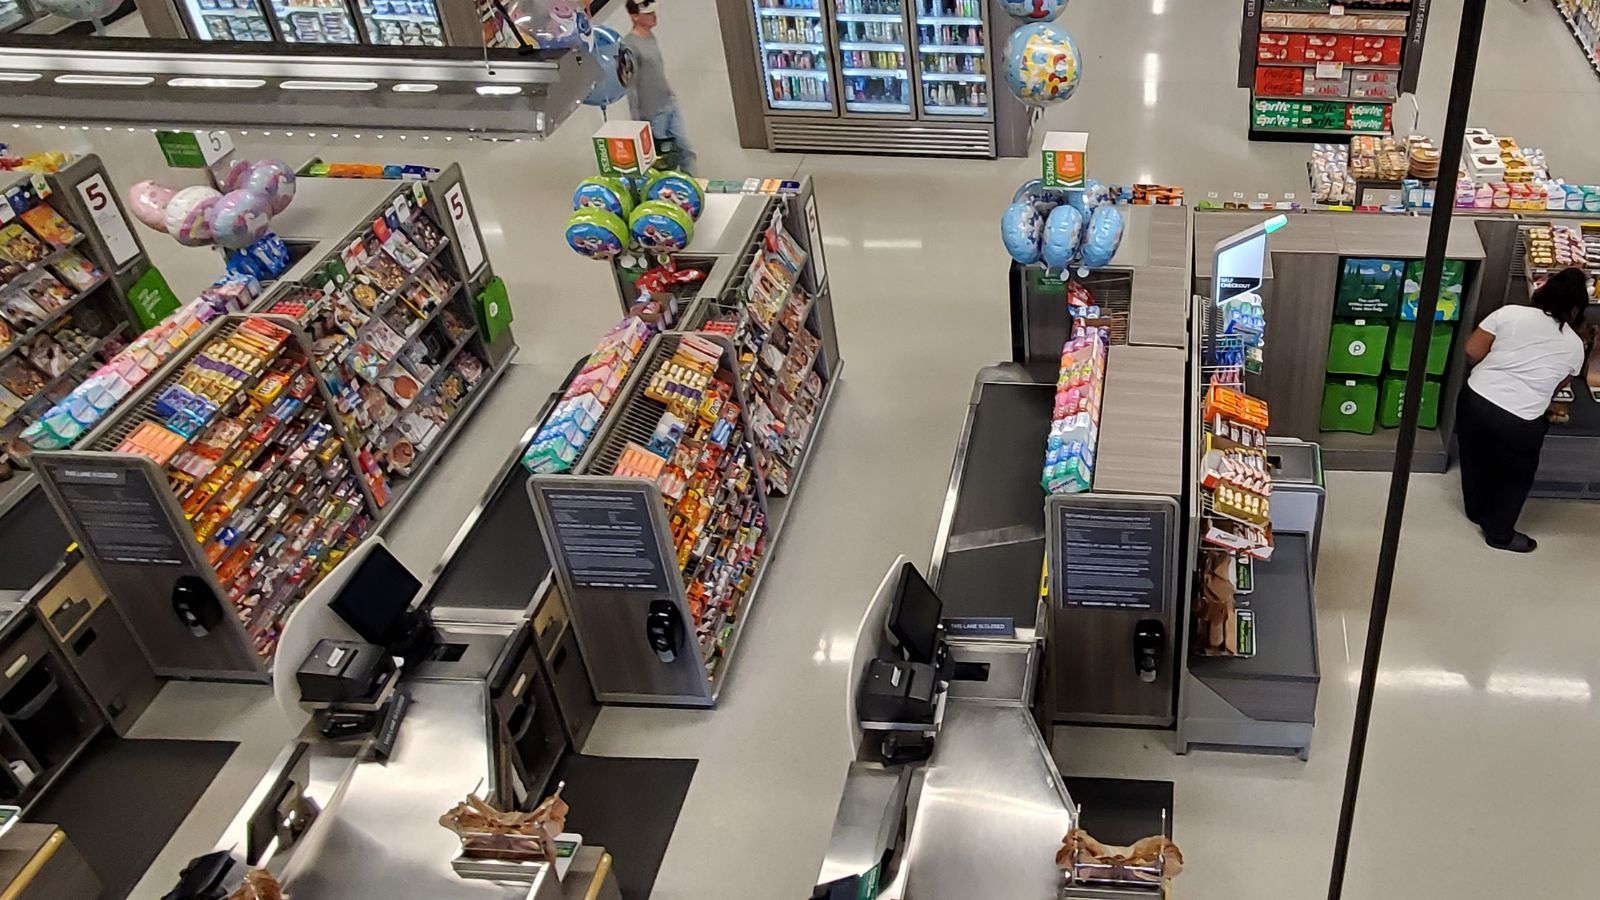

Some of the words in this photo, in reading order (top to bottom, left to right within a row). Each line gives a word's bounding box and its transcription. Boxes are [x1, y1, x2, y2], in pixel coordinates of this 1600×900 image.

[1256, 101, 1290, 113] Sprite
[1256, 114, 1290, 127] Sprite
[208, 130, 222, 152] 5
[596, 138, 611, 173] EXPRESS
[1045, 151, 1055, 186] EXPRESS
[85, 182, 107, 211] 5
[450, 191, 464, 220] 5
[808, 205, 816, 234] 5
